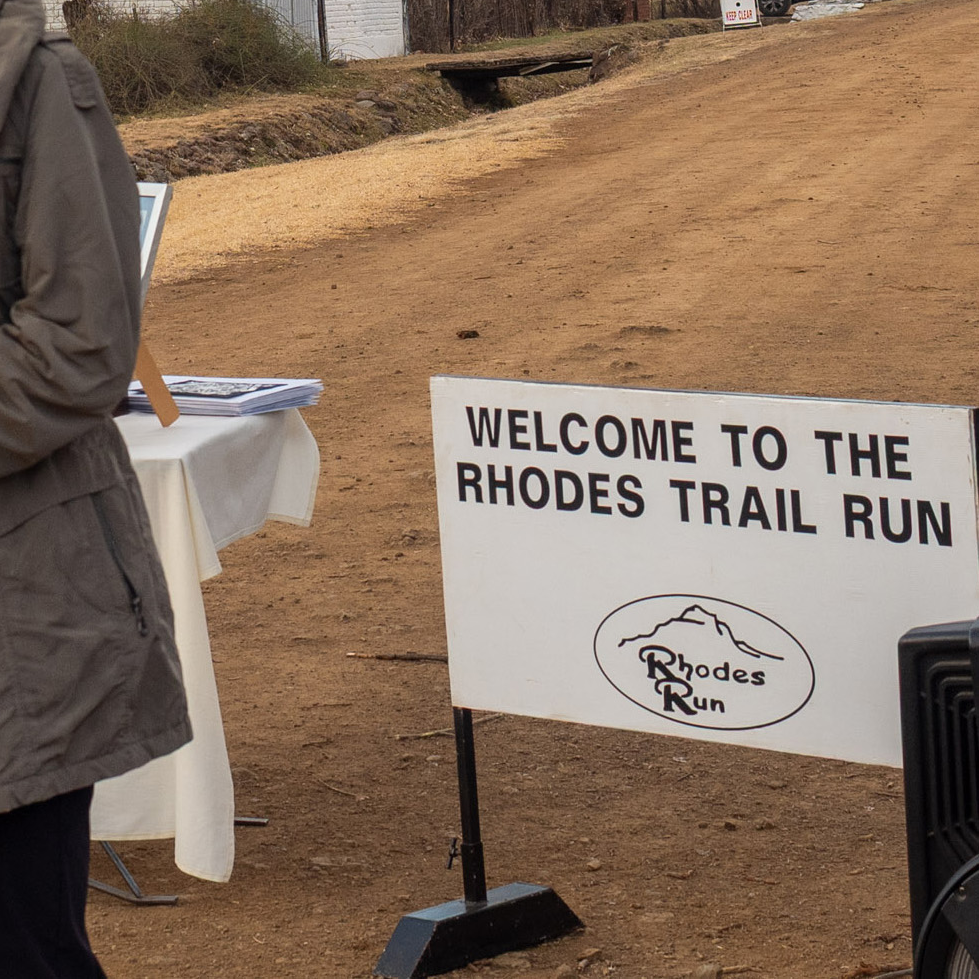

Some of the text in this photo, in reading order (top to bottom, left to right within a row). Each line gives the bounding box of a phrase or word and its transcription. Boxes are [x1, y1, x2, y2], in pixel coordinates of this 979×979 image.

[725, 9, 753, 21] KEEP CLEAR
[465, 405, 912, 481] WELCOME TO THE
[456, 461, 953, 547] RHODES TRAIL RUN
[639, 645, 766, 687] Rhodes
[655, 677, 725, 716] Run
